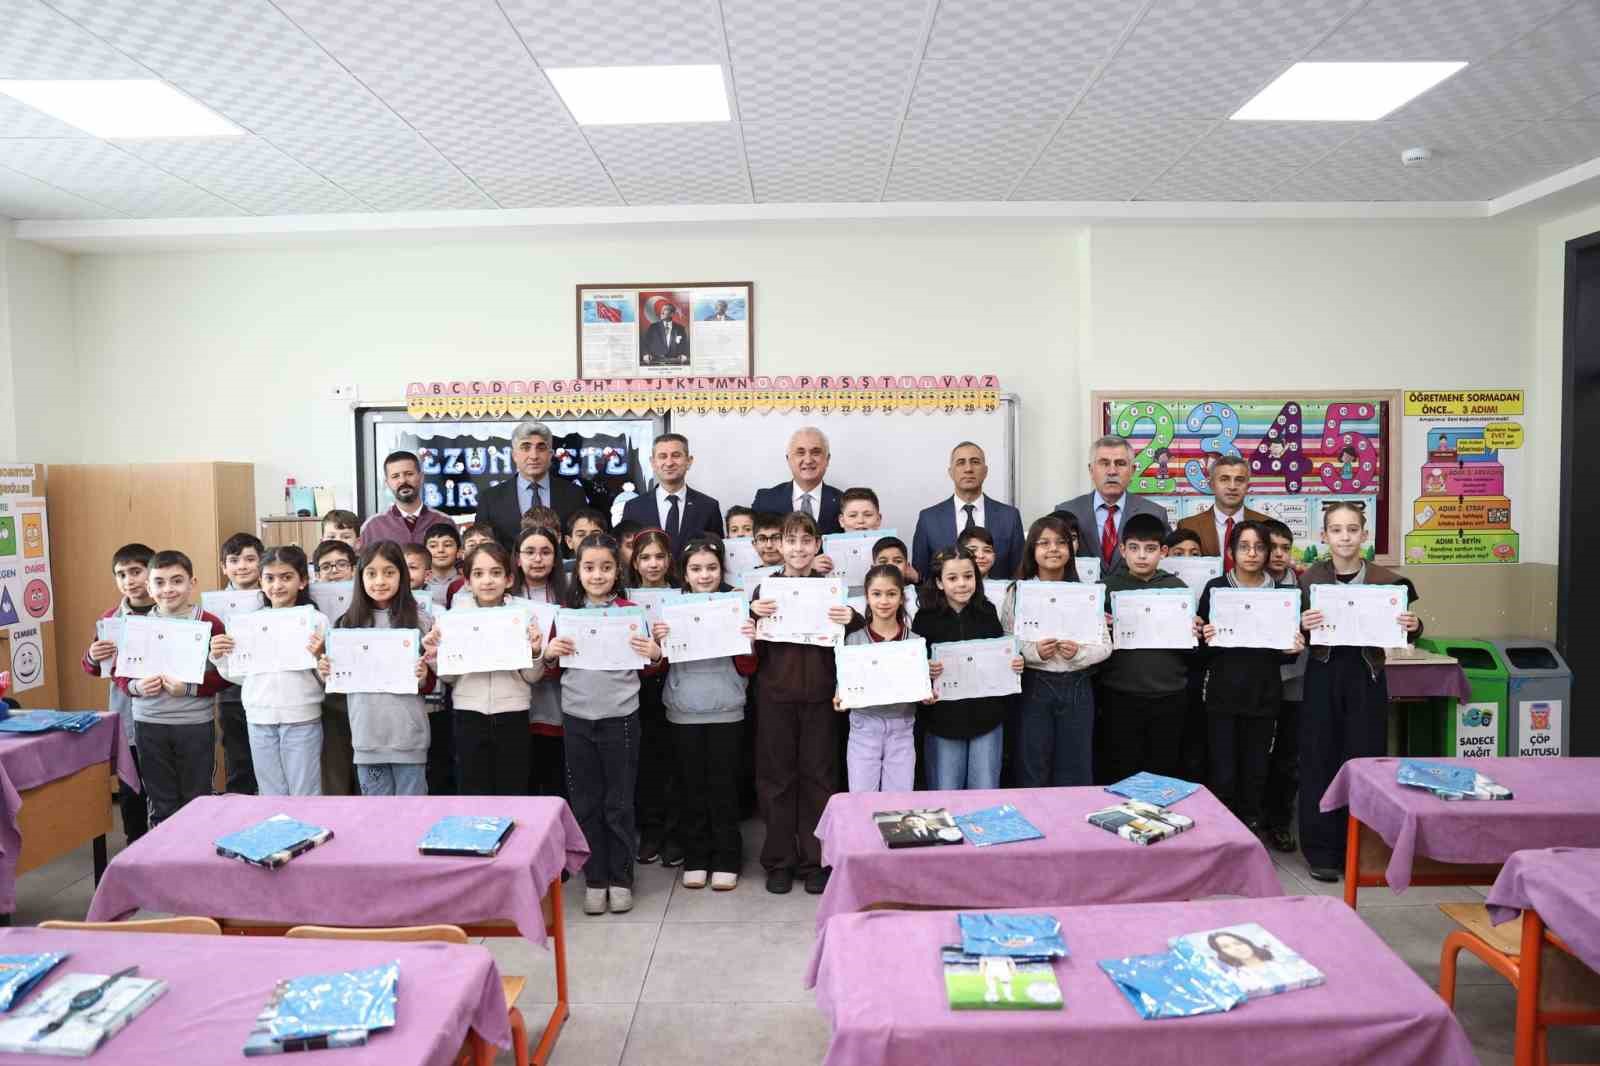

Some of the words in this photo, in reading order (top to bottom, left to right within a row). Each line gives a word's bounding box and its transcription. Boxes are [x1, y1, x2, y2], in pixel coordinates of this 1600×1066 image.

[433, 384, 441, 394] B
[452, 383, 460, 393] C
[472, 383, 481, 395] Ç
[493, 383, 502, 393] D
[534, 383, 541, 393] F
[553, 382, 562, 392] G
[594, 381, 603, 391] H
[656, 380, 662, 390] J
[676, 379, 685, 389] K
[698, 379, 704, 389] L
[716, 378, 728, 389] M
[738, 378, 747, 389] N
[801, 378, 809, 388] P
[821, 378, 829, 388] R
[842, 377, 849, 388] S
[863, 377, 870, 390] Ş
[883, 377, 890, 388] T
[944, 377, 952, 388] V
[965, 377, 974, 388] Y
[985, 377, 993, 387] Z
[1409, 392, 1464, 402] ÖĞRETMENE
[1467, 393, 1520, 402] SORMADAN
[1462, 406, 1468, 414] 3
[1471, 405, 1498, 414] ADIM!
[1116, 400, 1176, 494] 2
[1184, 400, 1242, 495] 3
[1248, 400, 1313, 494] 4
[1320, 402, 1377, 494] 5
[423, 479, 478, 507] BİR
[13, 628, 37, 641] ÇEMBER
[1460, 736, 1495, 746] SADECE
[1530, 733, 1550, 746] ÇÖP
[1463, 746, 1491, 758] KAĞIT
[1520, 748, 1560, 757] KUTUSU
